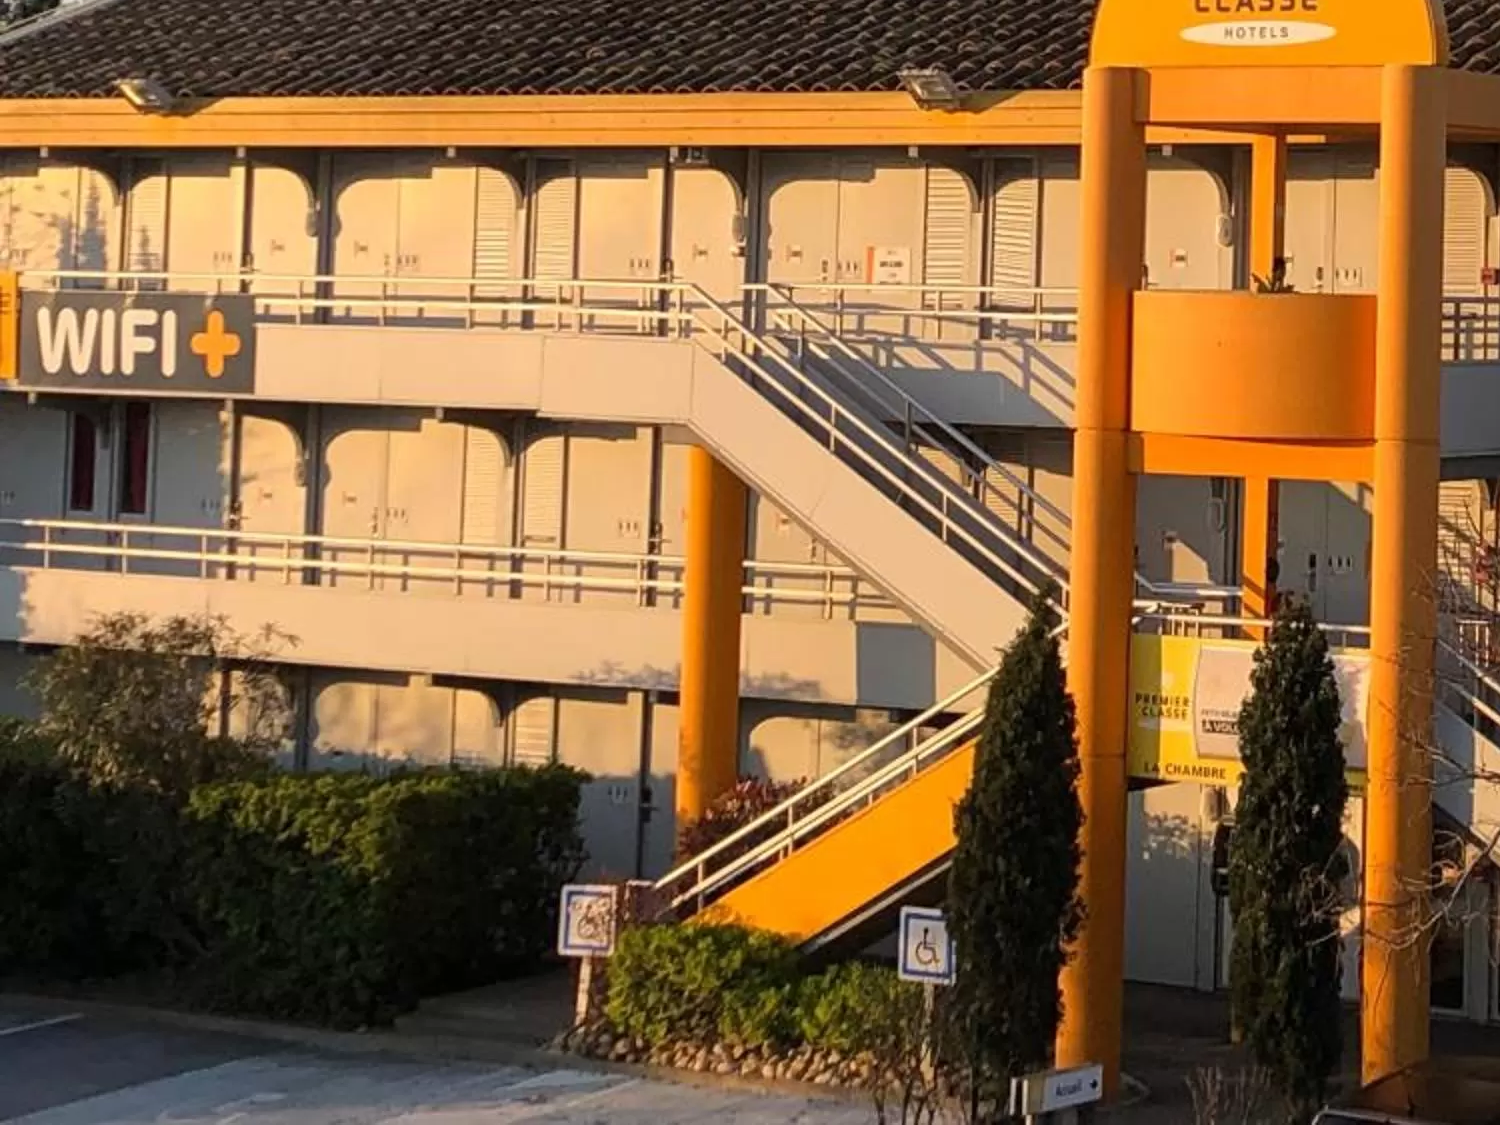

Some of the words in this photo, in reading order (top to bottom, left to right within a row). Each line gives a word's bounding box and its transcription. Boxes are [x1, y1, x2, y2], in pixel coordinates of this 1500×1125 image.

[1224, 26, 1289, 39] HOTELS
[37, 306, 176, 377] WIFI
[1164, 762, 1227, 780] CHAMBRE
